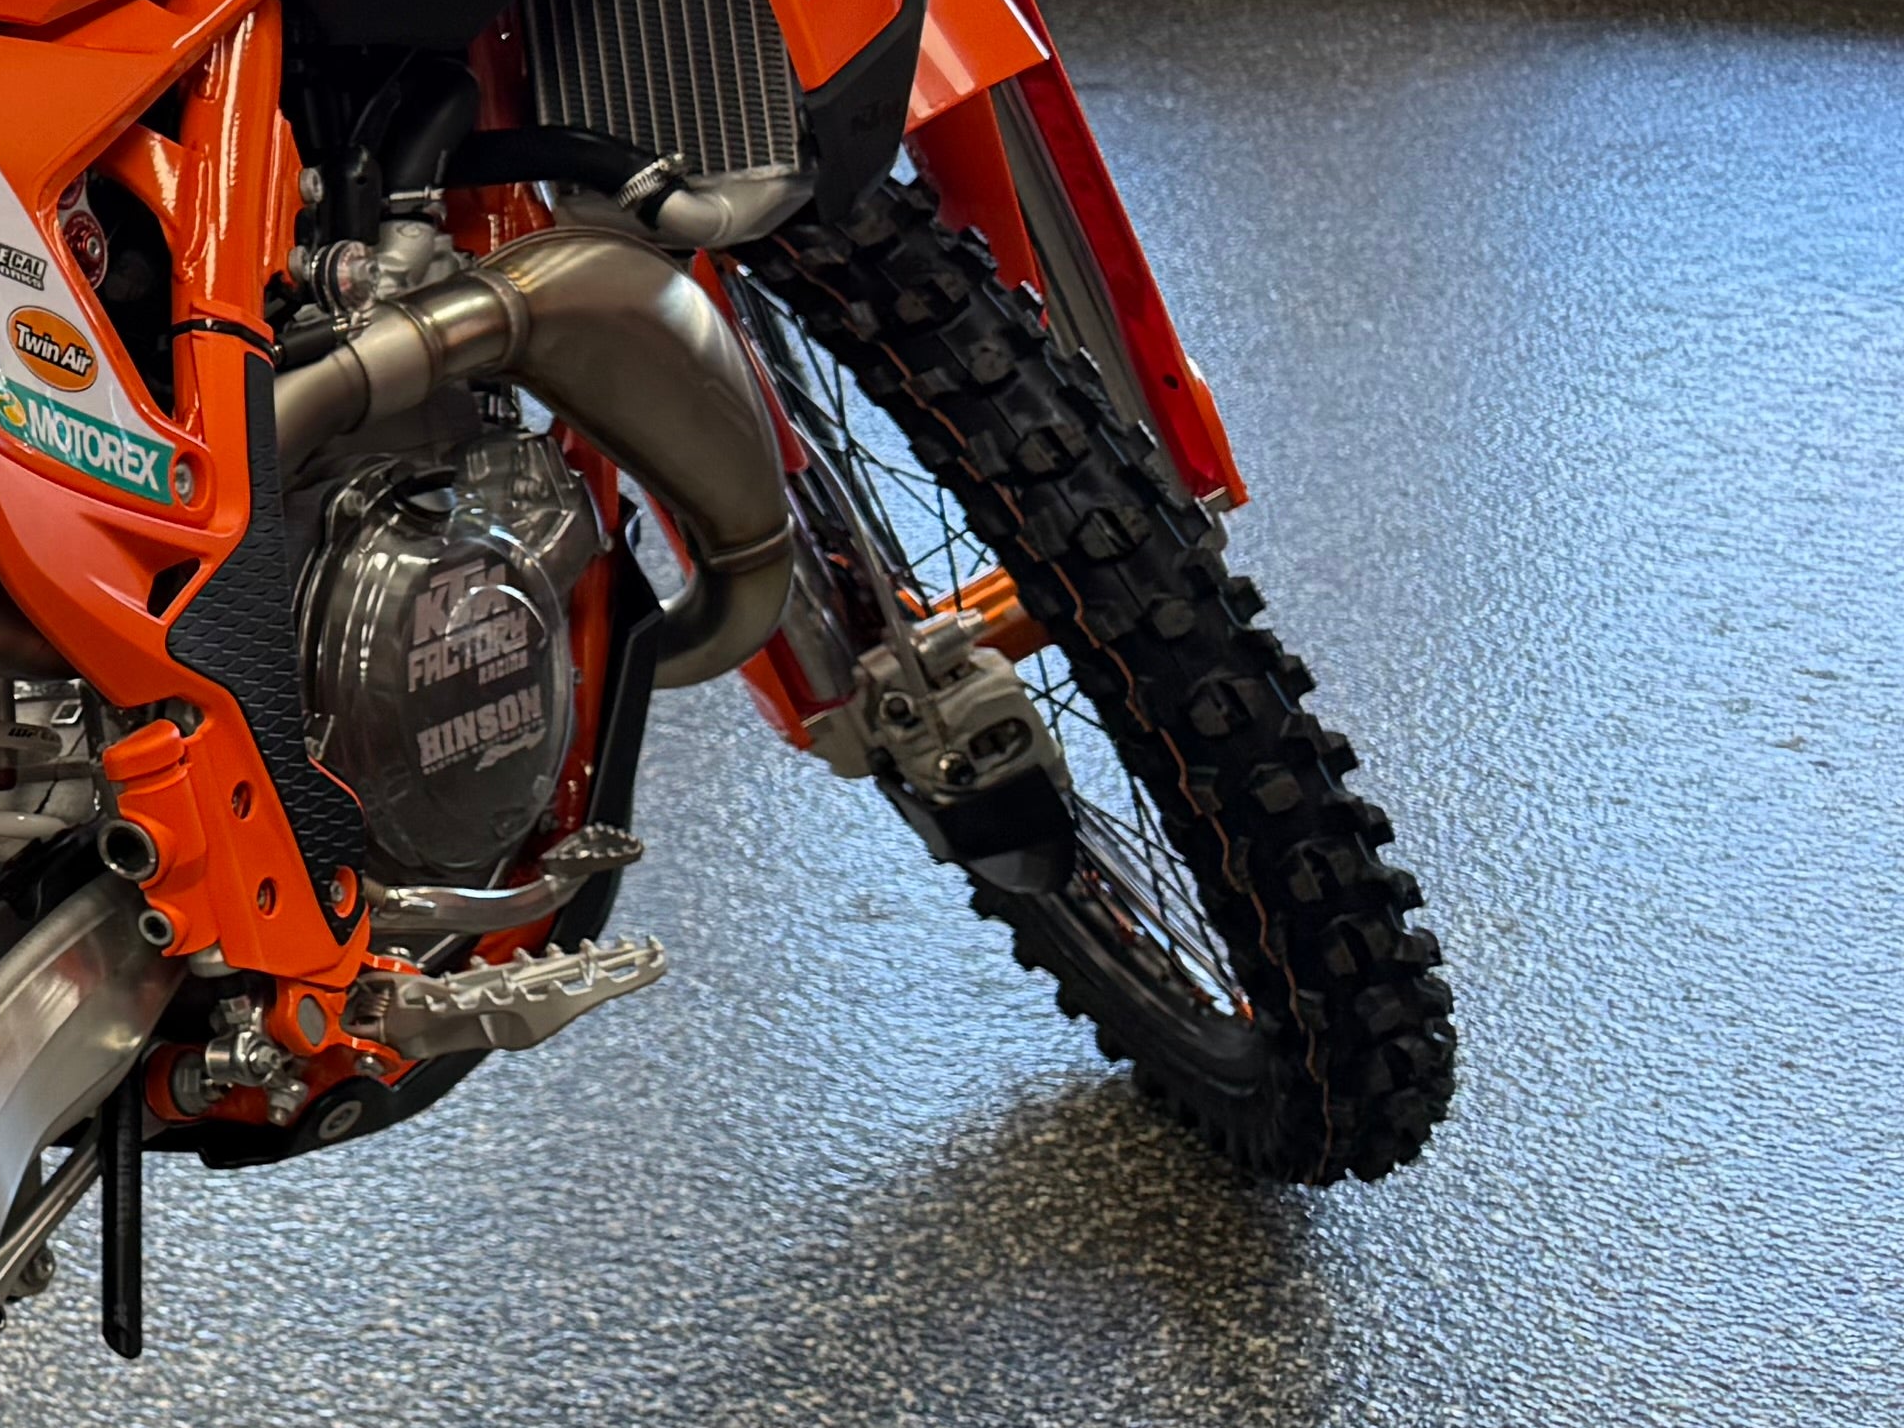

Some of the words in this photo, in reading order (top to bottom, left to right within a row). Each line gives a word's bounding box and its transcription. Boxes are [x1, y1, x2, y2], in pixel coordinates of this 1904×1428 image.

[15, 323, 60, 363] Twin
[61, 345, 92, 375] Air
[27, 398, 161, 491] MOTOREX
[413, 558, 509, 646] KTM
[407, 607, 530, 693] FACTORY
[417, 684, 543, 770] HINSON
